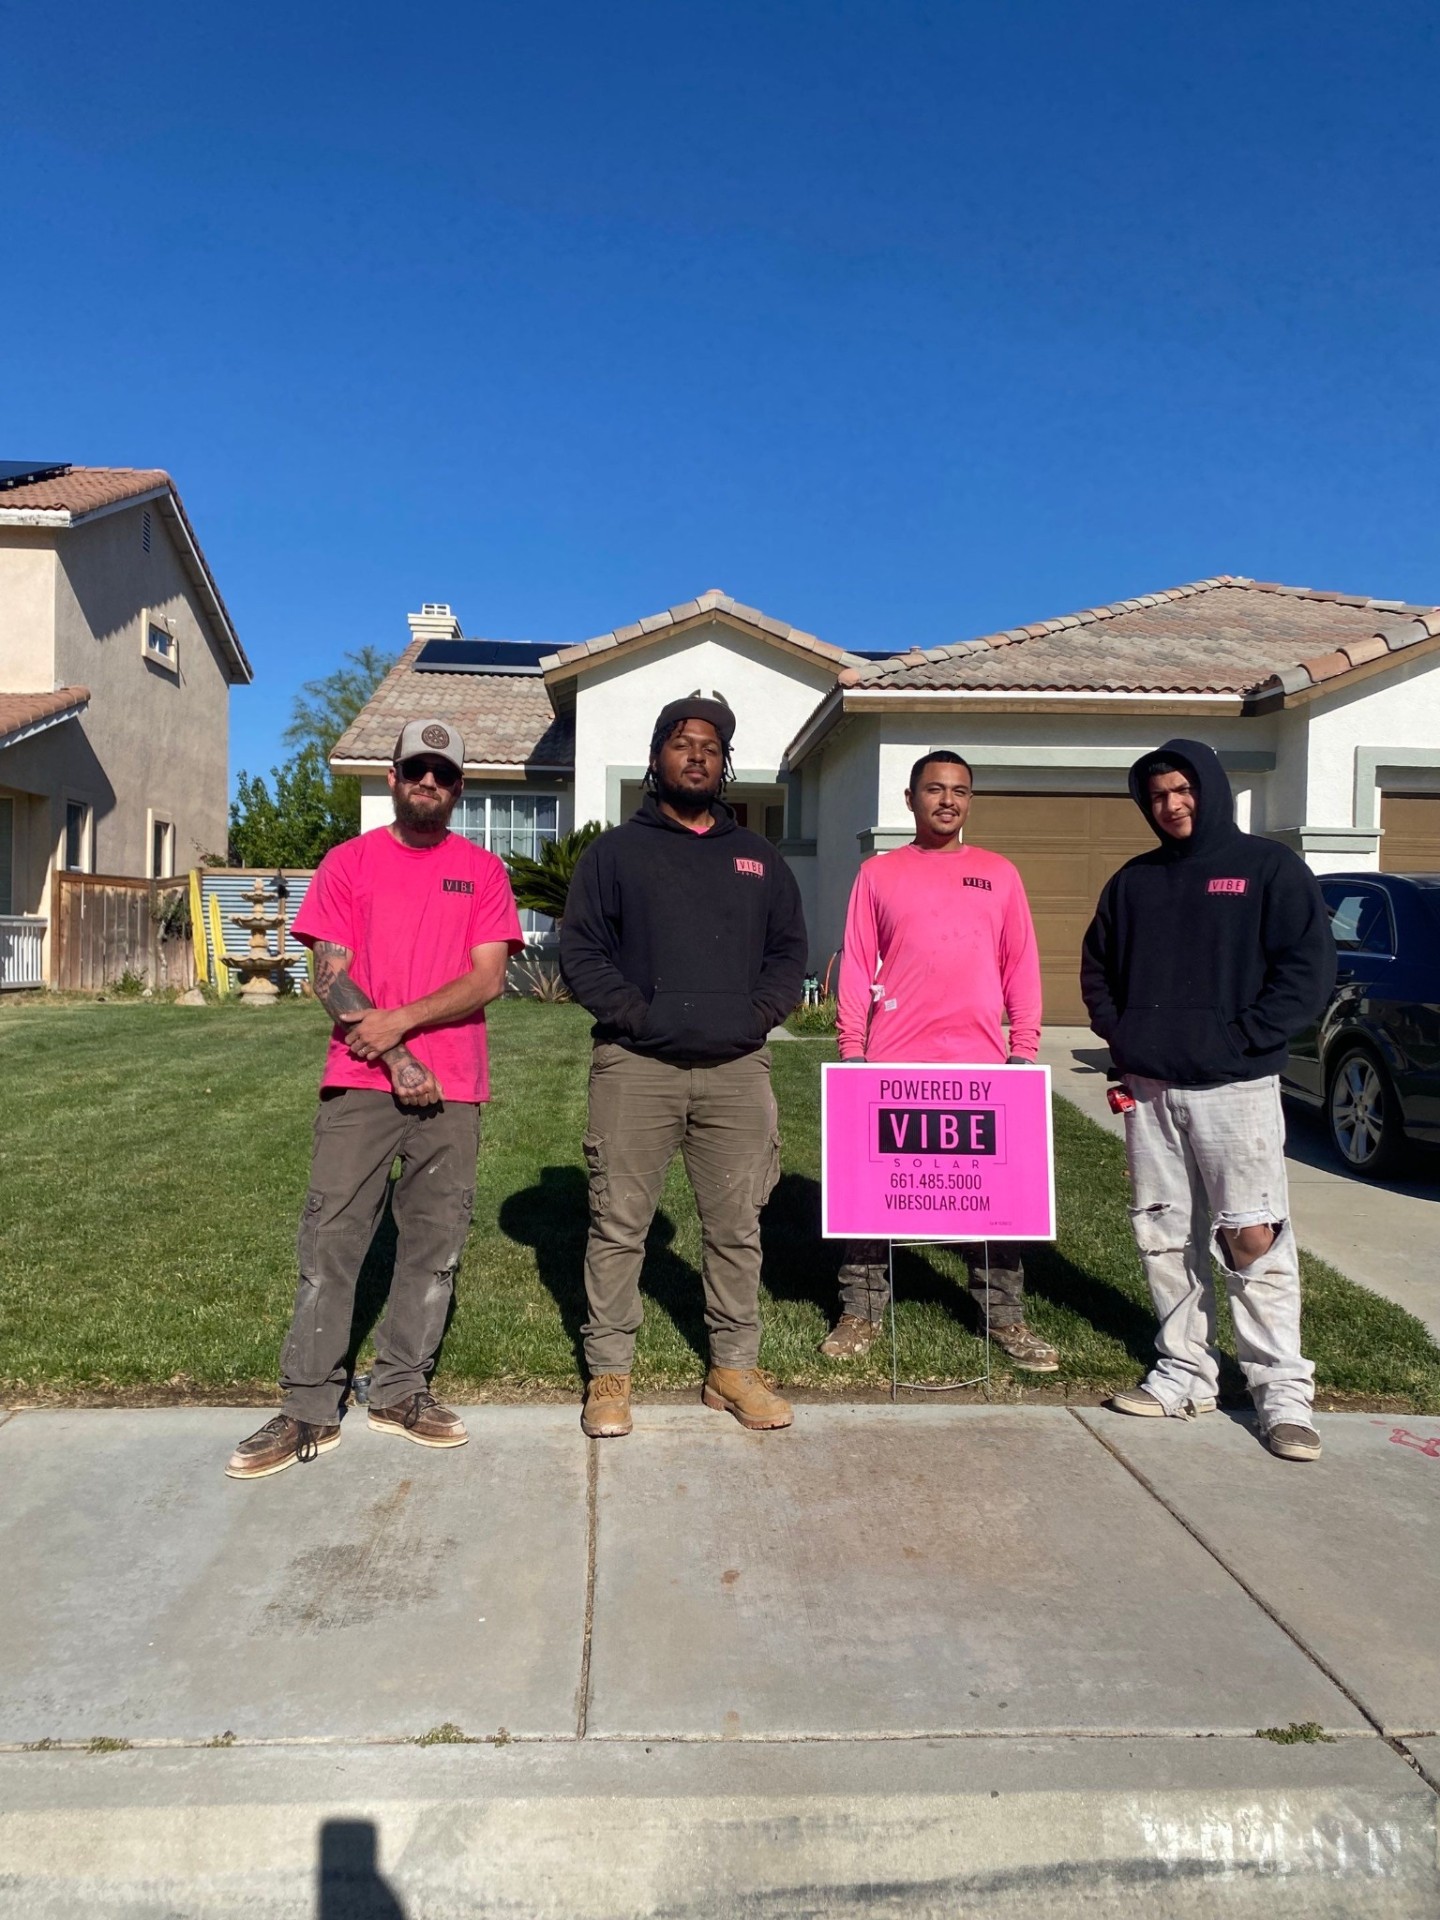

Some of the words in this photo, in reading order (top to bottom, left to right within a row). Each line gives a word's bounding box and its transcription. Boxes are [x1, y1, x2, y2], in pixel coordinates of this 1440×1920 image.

[738, 860, 763, 874] VIBE
[965, 878, 991, 890] VIBE
[1211, 880, 1242, 891] VIBE
[880, 1080, 963, 1101] POWERED
[969, 1081, 992, 1101] BY
[889, 1113, 986, 1150] VIBE
[894, 1158, 980, 1169] SOLAR
[890, 1173, 982, 1189] 661.485.5000
[885, 1194, 990, 1211] VIBESOLAR.COM
